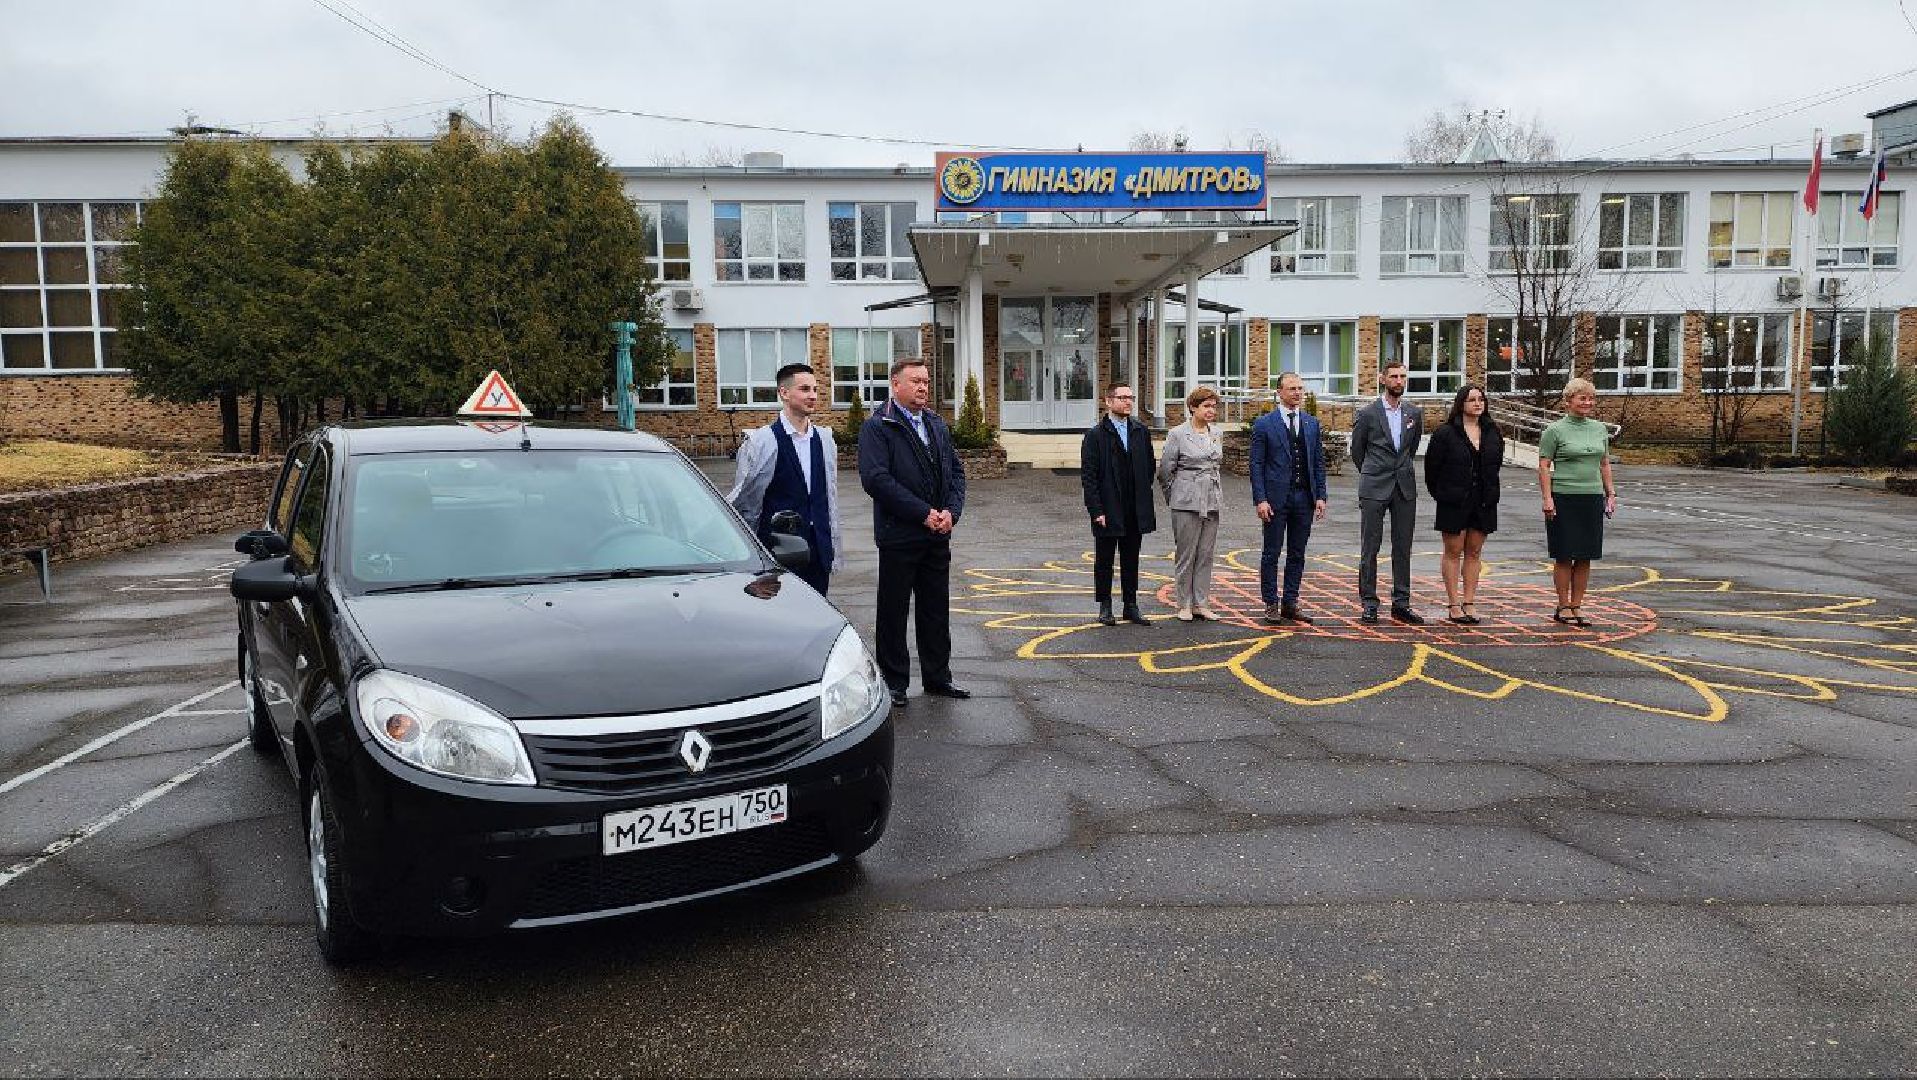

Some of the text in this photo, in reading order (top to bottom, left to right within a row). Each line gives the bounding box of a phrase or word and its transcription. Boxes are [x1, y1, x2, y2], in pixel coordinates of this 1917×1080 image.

[987, 166, 1262, 199] ГИМНАЗИЯ «ДМИТРОВ»
[490, 392, 504, 407] У
[741, 789, 781, 817] 750
[749, 812, 770, 824] RUS
